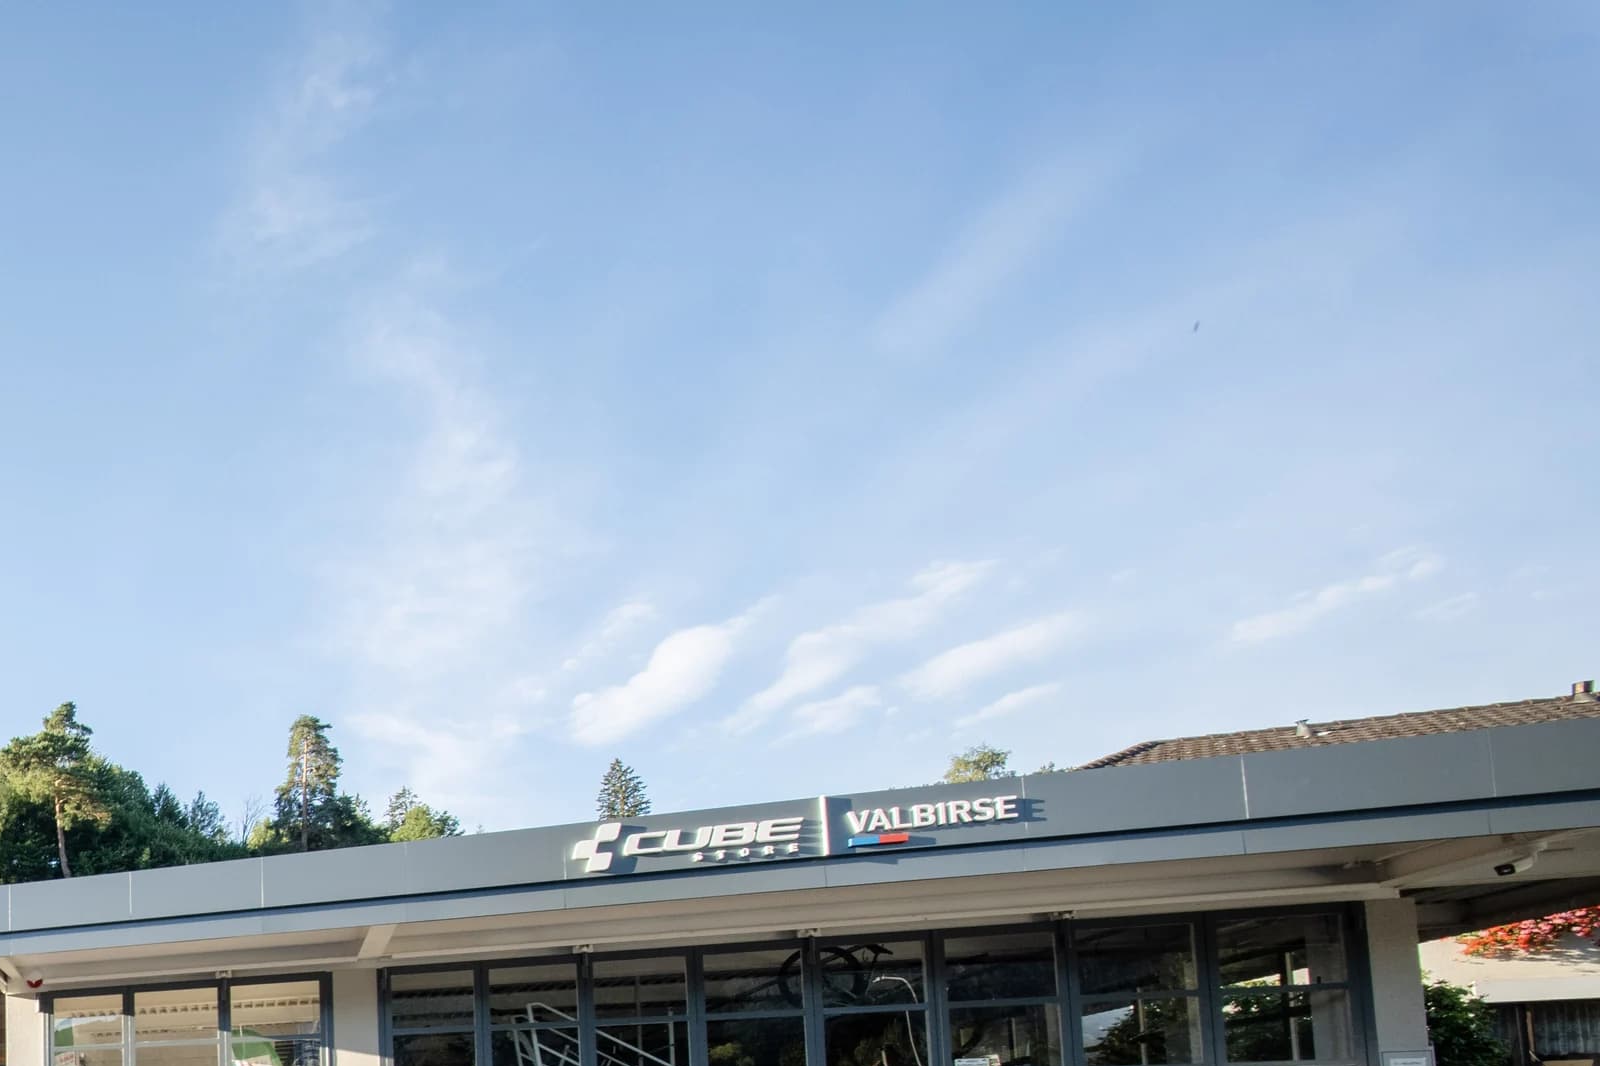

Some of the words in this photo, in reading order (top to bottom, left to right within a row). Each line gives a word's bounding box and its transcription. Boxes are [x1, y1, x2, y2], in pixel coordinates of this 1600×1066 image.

[845, 795, 1019, 835] VALBIRSE
[622, 816, 805, 857] CUBE
[691, 842, 800, 863] STORE
